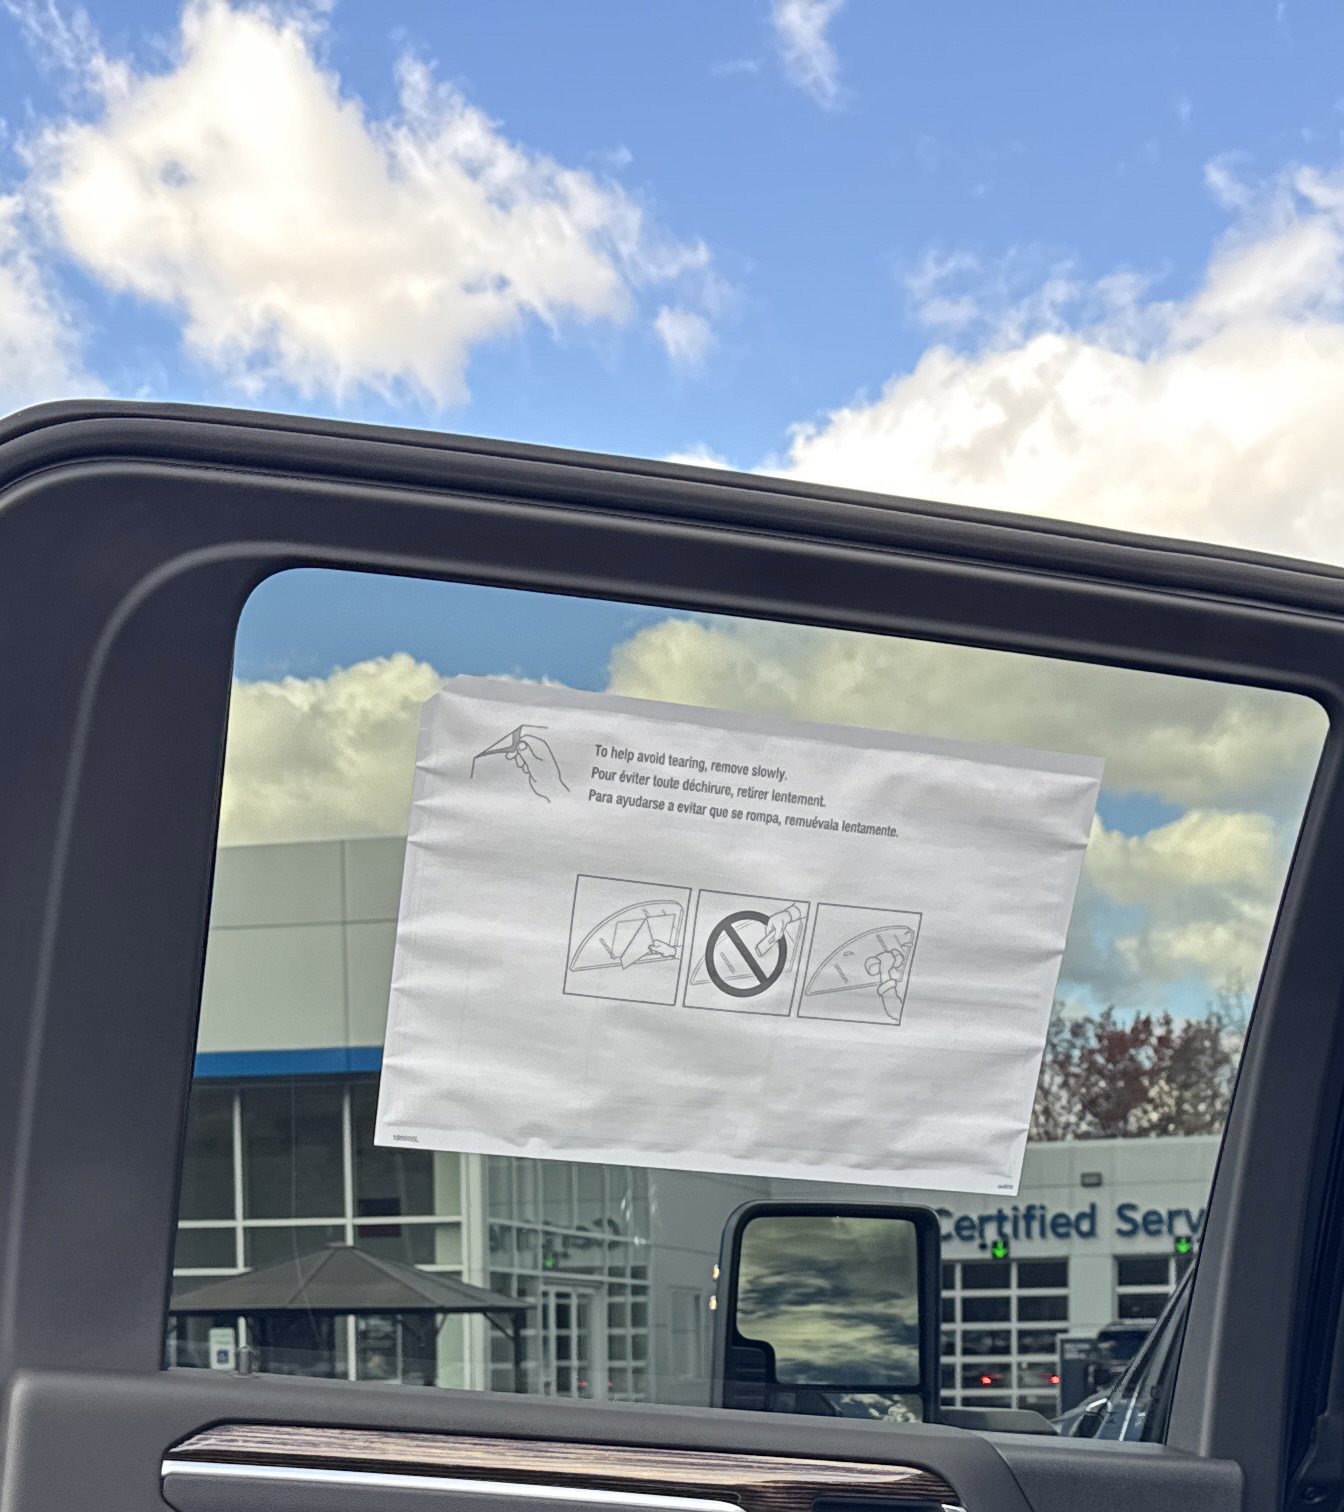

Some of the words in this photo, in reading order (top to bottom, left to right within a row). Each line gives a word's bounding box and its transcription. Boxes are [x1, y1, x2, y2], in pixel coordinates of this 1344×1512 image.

[595, 744, 608, 757] To
[610, 746, 634, 763] help
[637, 752, 665, 765] avoid
[668, 754, 707, 773] tearing,
[710, 761, 749, 776] remove
[751, 765, 788, 782] slowly.
[591, 766, 617, 781] Pour
[619, 770, 650, 786] éviter
[653, 776, 680, 789] toute
[682, 778, 734, 798] déchirure,
[737, 786, 769, 801] retirer
[771, 789, 826, 807] lentement.
[588, 789, 613, 803] Para
[616, 794, 665, 811] ayudarse
[667, 801, 674, 812] a
[677, 802, 707, 816] evitar
[709, 806, 729, 821] que
[731, 808, 743, 820] se
[745, 810, 781, 826] rompa,
[784, 815, 839, 831] remuévala
[841, 820, 899, 838] lentamente.
